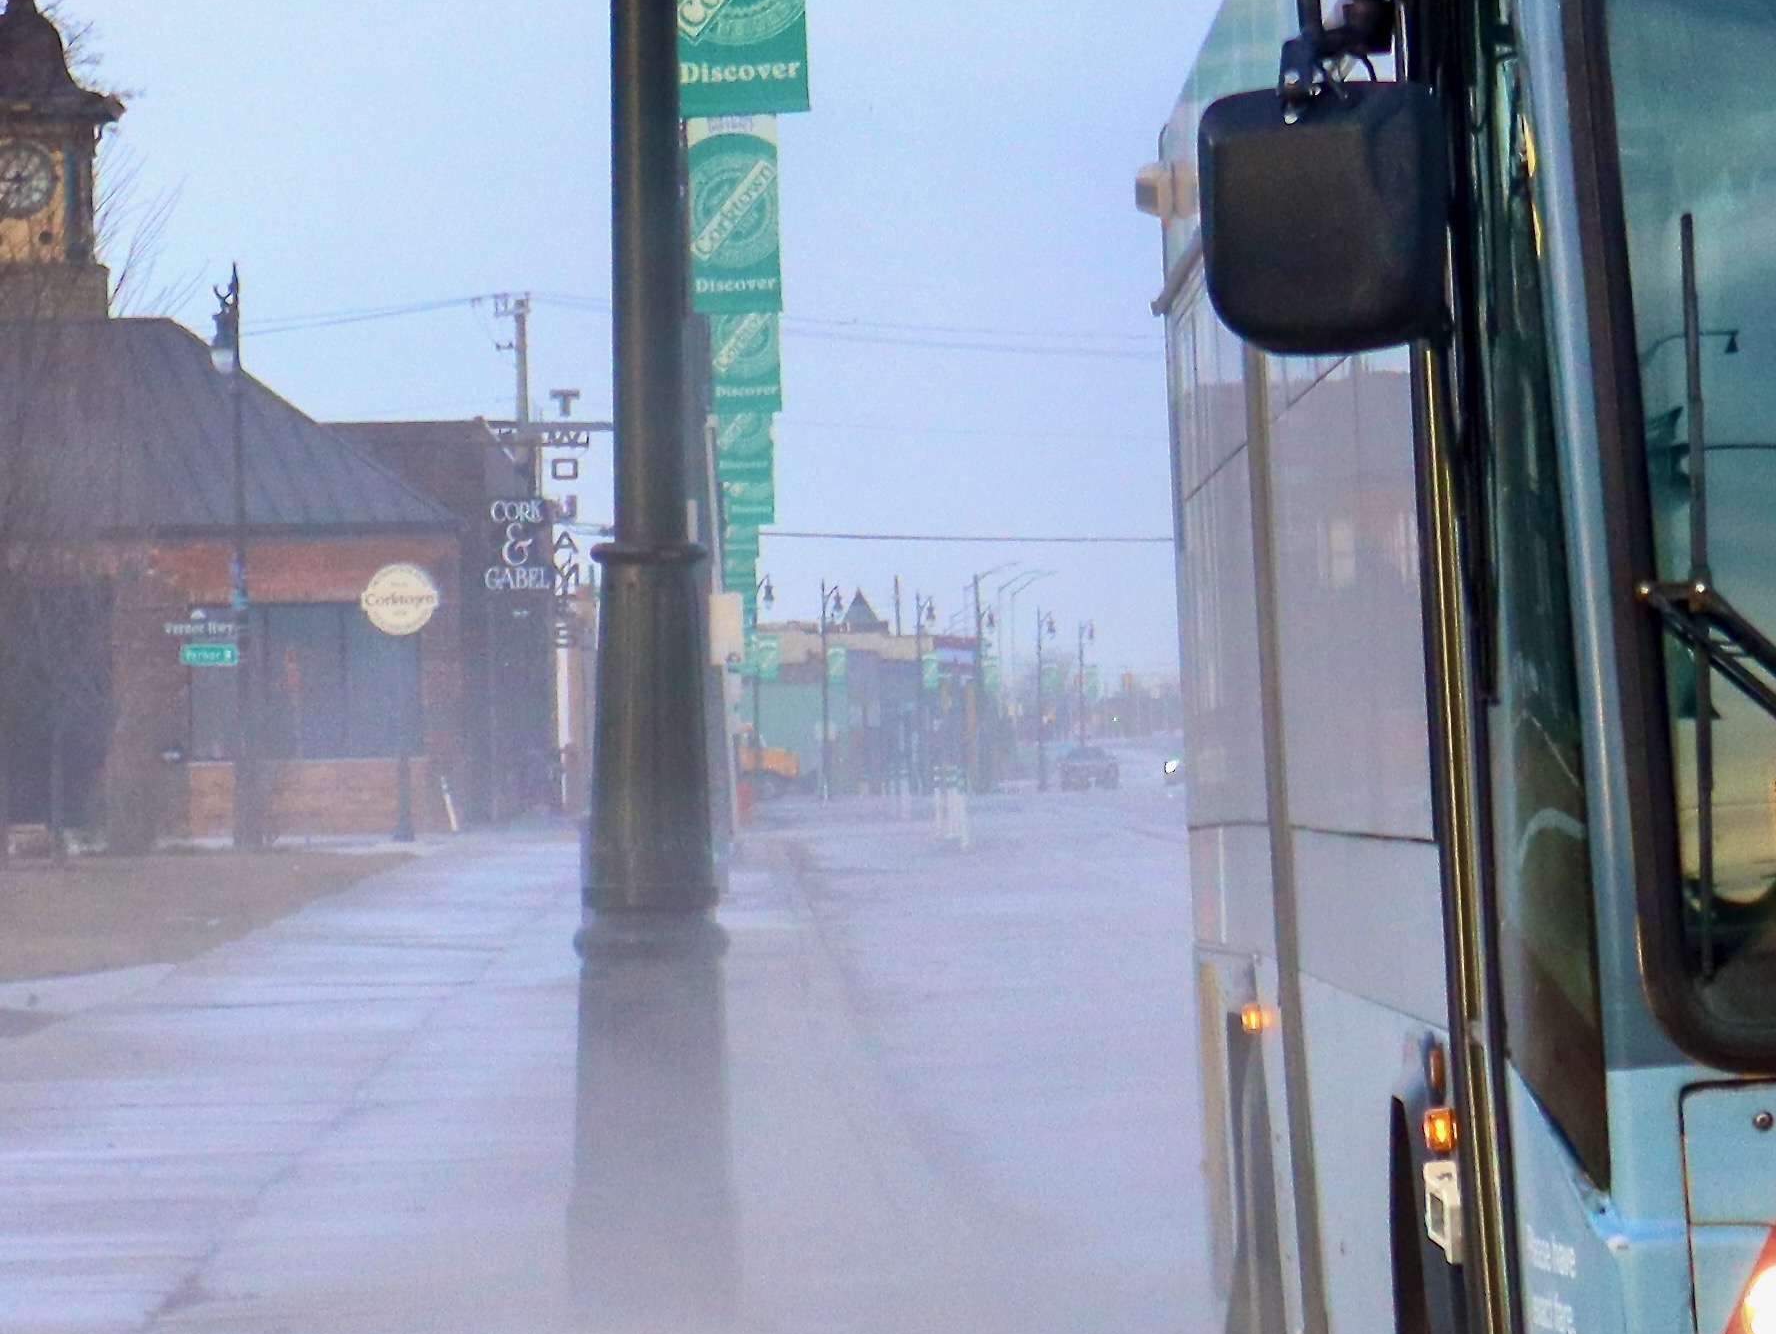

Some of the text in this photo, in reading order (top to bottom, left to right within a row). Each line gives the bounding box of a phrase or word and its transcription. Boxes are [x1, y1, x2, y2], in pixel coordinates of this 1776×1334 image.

[679, 62, 800, 84] Discover
[695, 277, 776, 294] Discover
[490, 500, 542, 523] CORK
[501, 522, 533, 565] &
[484, 567, 550, 591] GABEL
[365, 592, 434, 606] Corktown
